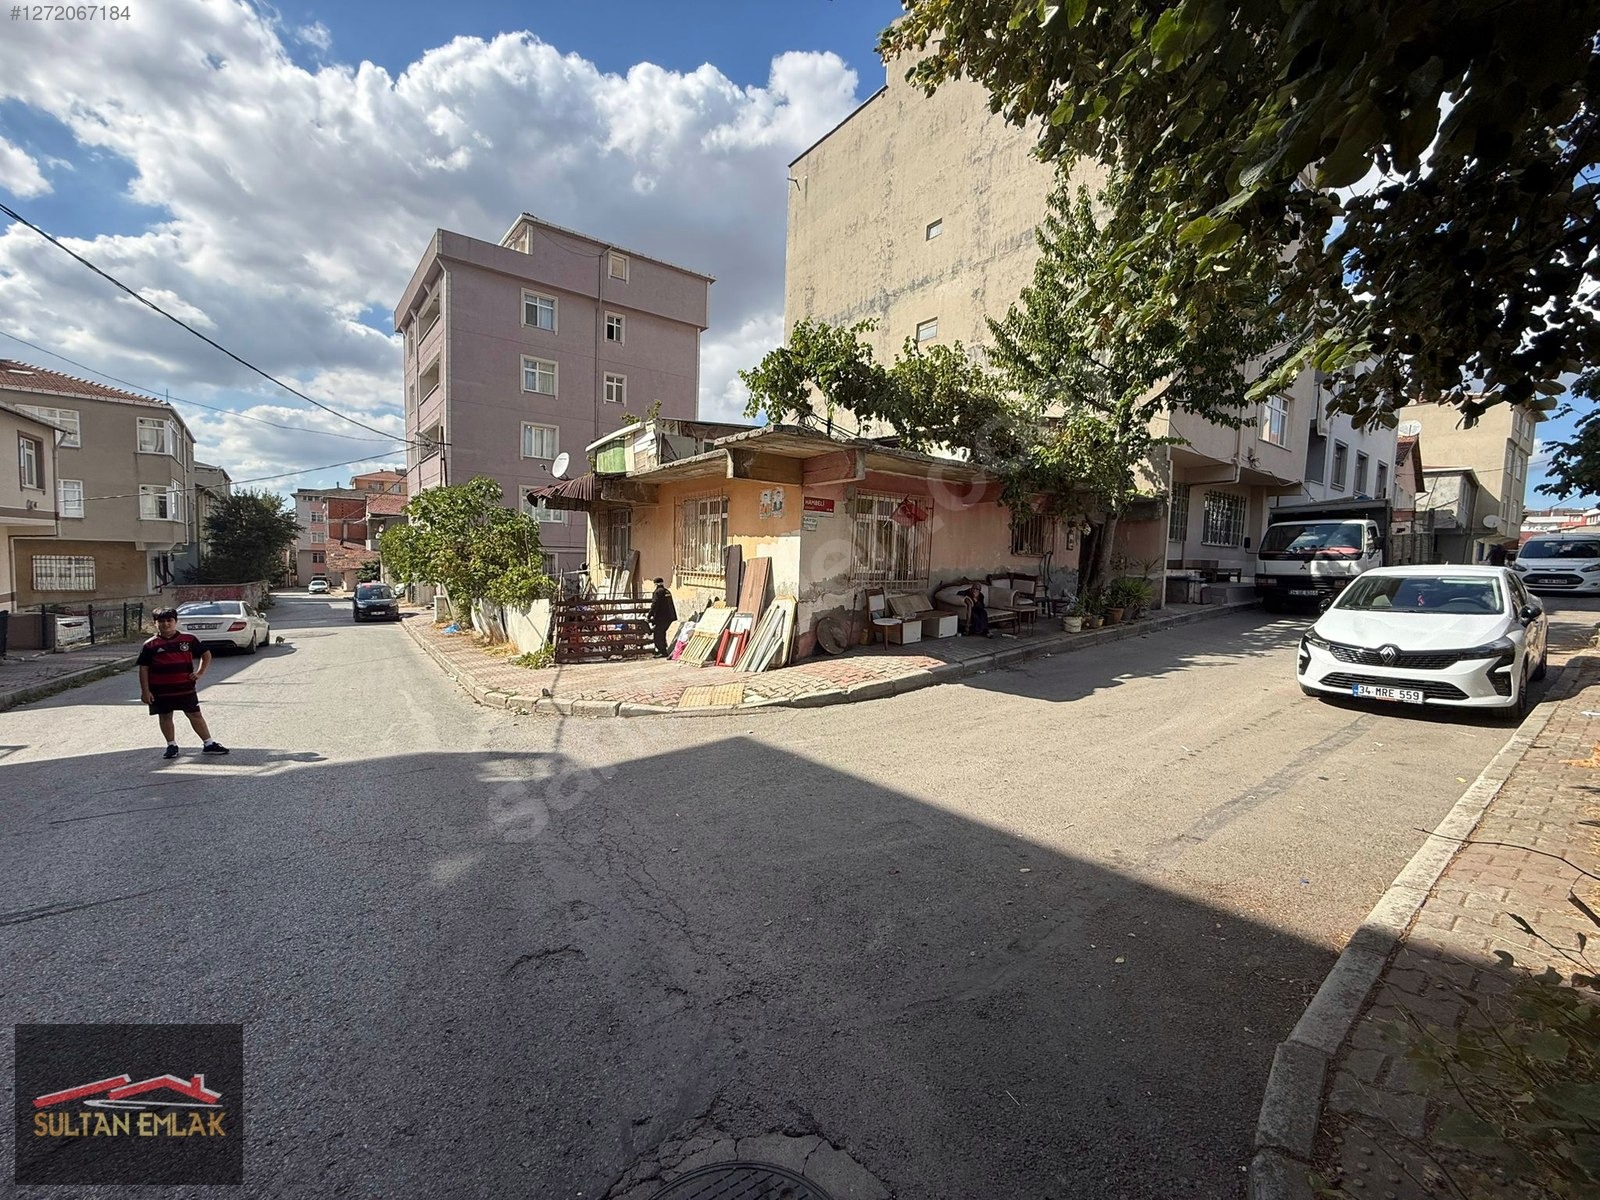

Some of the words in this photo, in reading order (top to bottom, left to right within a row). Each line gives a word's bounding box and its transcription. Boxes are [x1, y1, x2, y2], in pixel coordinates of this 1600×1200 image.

[1358, 685, 1371, 695] 34
[1375, 687, 1395, 698] MRE
[1399, 690, 1420, 701] 559
